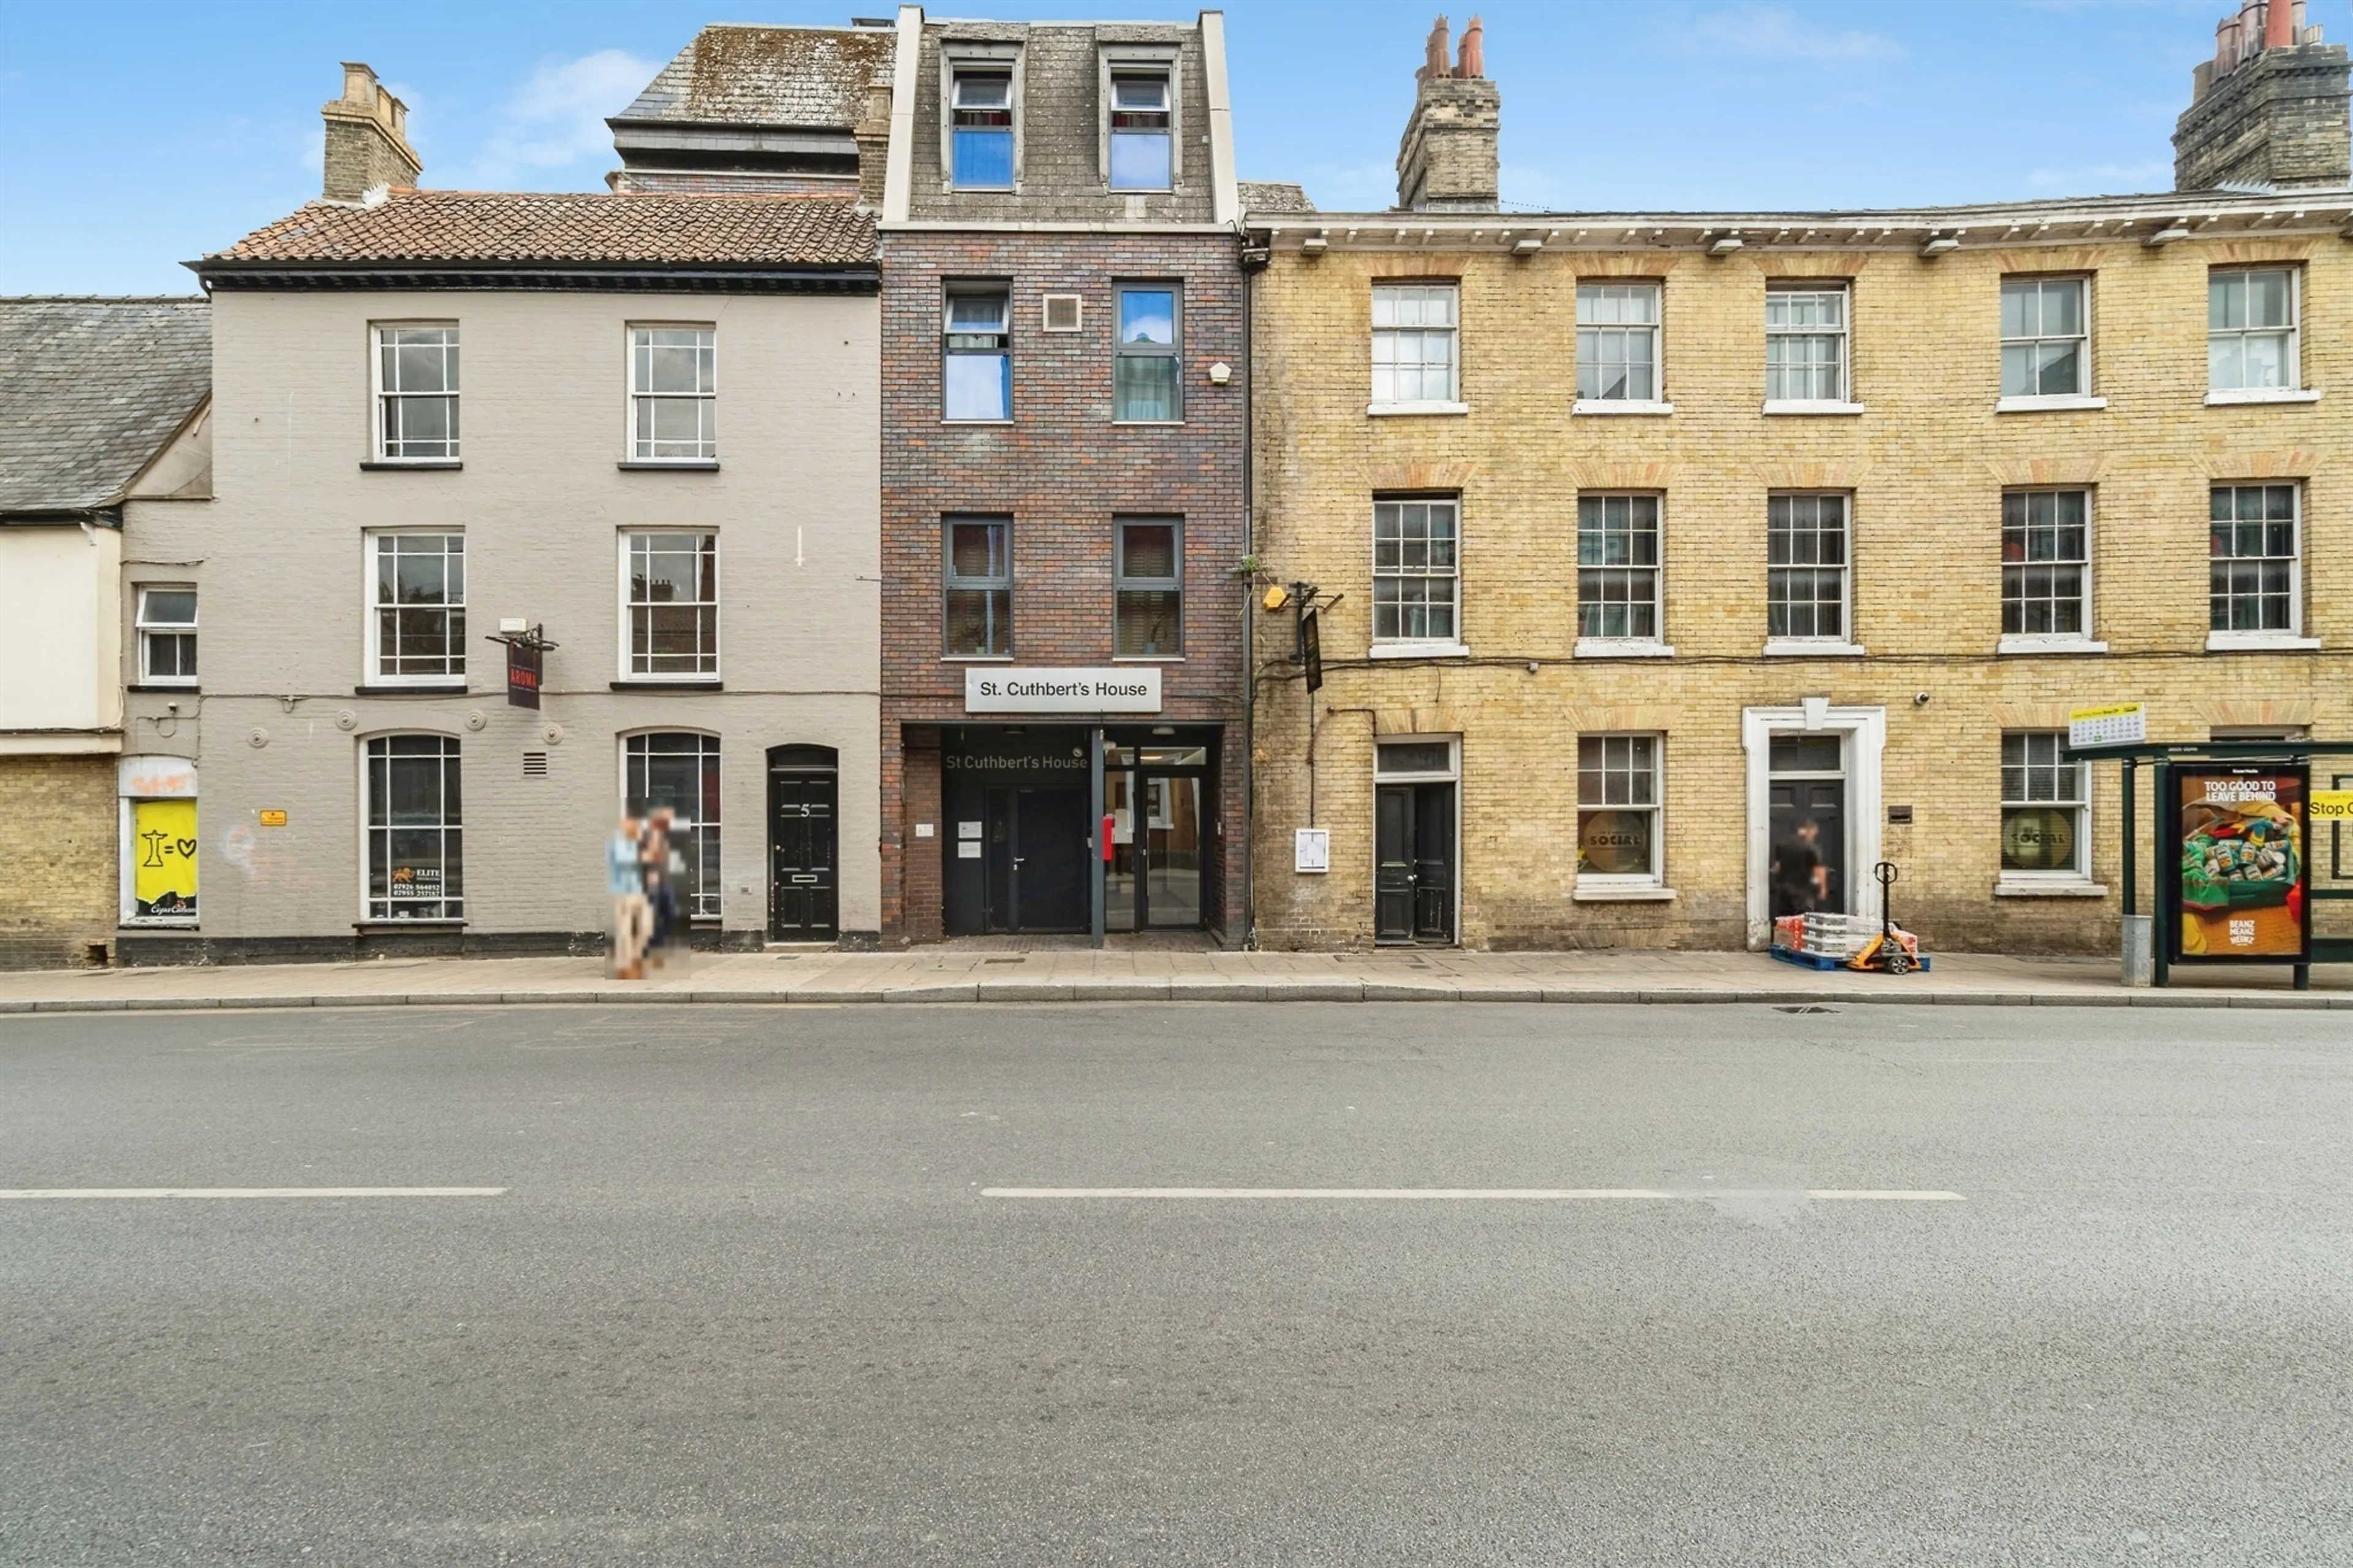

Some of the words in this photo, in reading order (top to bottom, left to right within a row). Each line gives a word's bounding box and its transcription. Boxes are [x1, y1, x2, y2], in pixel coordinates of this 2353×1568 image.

[509, 667, 537, 688] AROMA
[980, 682, 1002, 696] St.
[1007, 681, 1089, 696] Cuthbert's
[1096, 682, 1147, 696] House
[946, 756, 961, 768] St
[964, 756, 1039, 768] Cuthbert's
[1043, 756, 1088, 768] House
[2203, 781, 2227, 791] TOO
[2229, 781, 2260, 791] GOOD
[2260, 781, 2276, 791] TO
[2206, 791, 2236, 801] LEAVE
[2238, 791, 2276, 801] BEHIND
[800, 803, 810, 818] 5
[2310, 801, 2344, 816] Stop
[1590, 835, 1642, 846] SOCIAL
[2010, 833, 2066, 844] SOCAL
[417, 868, 441, 877] ELITE
[2230, 935, 2255, 944] HEINZ
